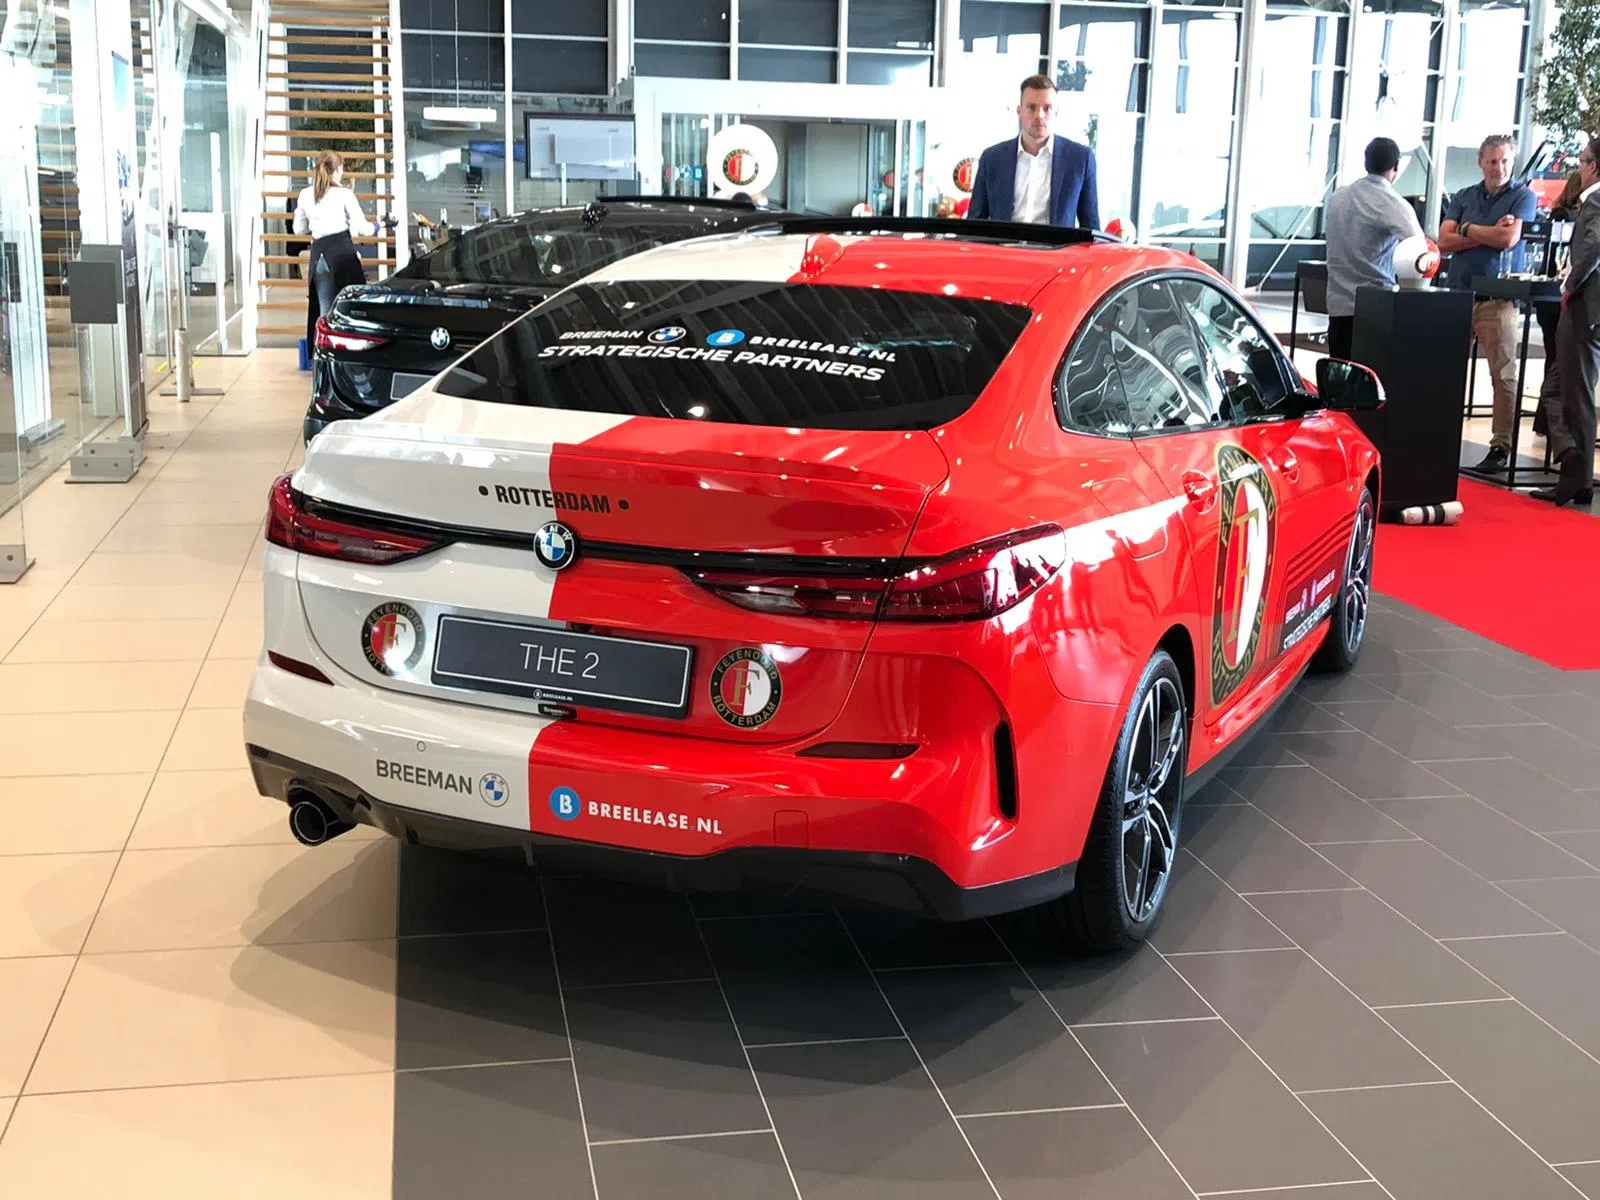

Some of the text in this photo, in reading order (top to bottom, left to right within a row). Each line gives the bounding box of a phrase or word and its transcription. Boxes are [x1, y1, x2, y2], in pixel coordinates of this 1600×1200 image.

[559, 330, 645, 341] BREEMAN
[716, 332, 897, 362] B BREELEASE.NL
[538, 346, 886, 381] STRATEGISCHE PARTNERS
[495, 484, 611, 514] ROTTERDAM
[520, 642, 600, 679] THE 2
[713, 695, 777, 726] ROTTERDAM
[376, 759, 473, 795] BREEMAN
[560, 793, 723, 836] B BREELEASE.NL
